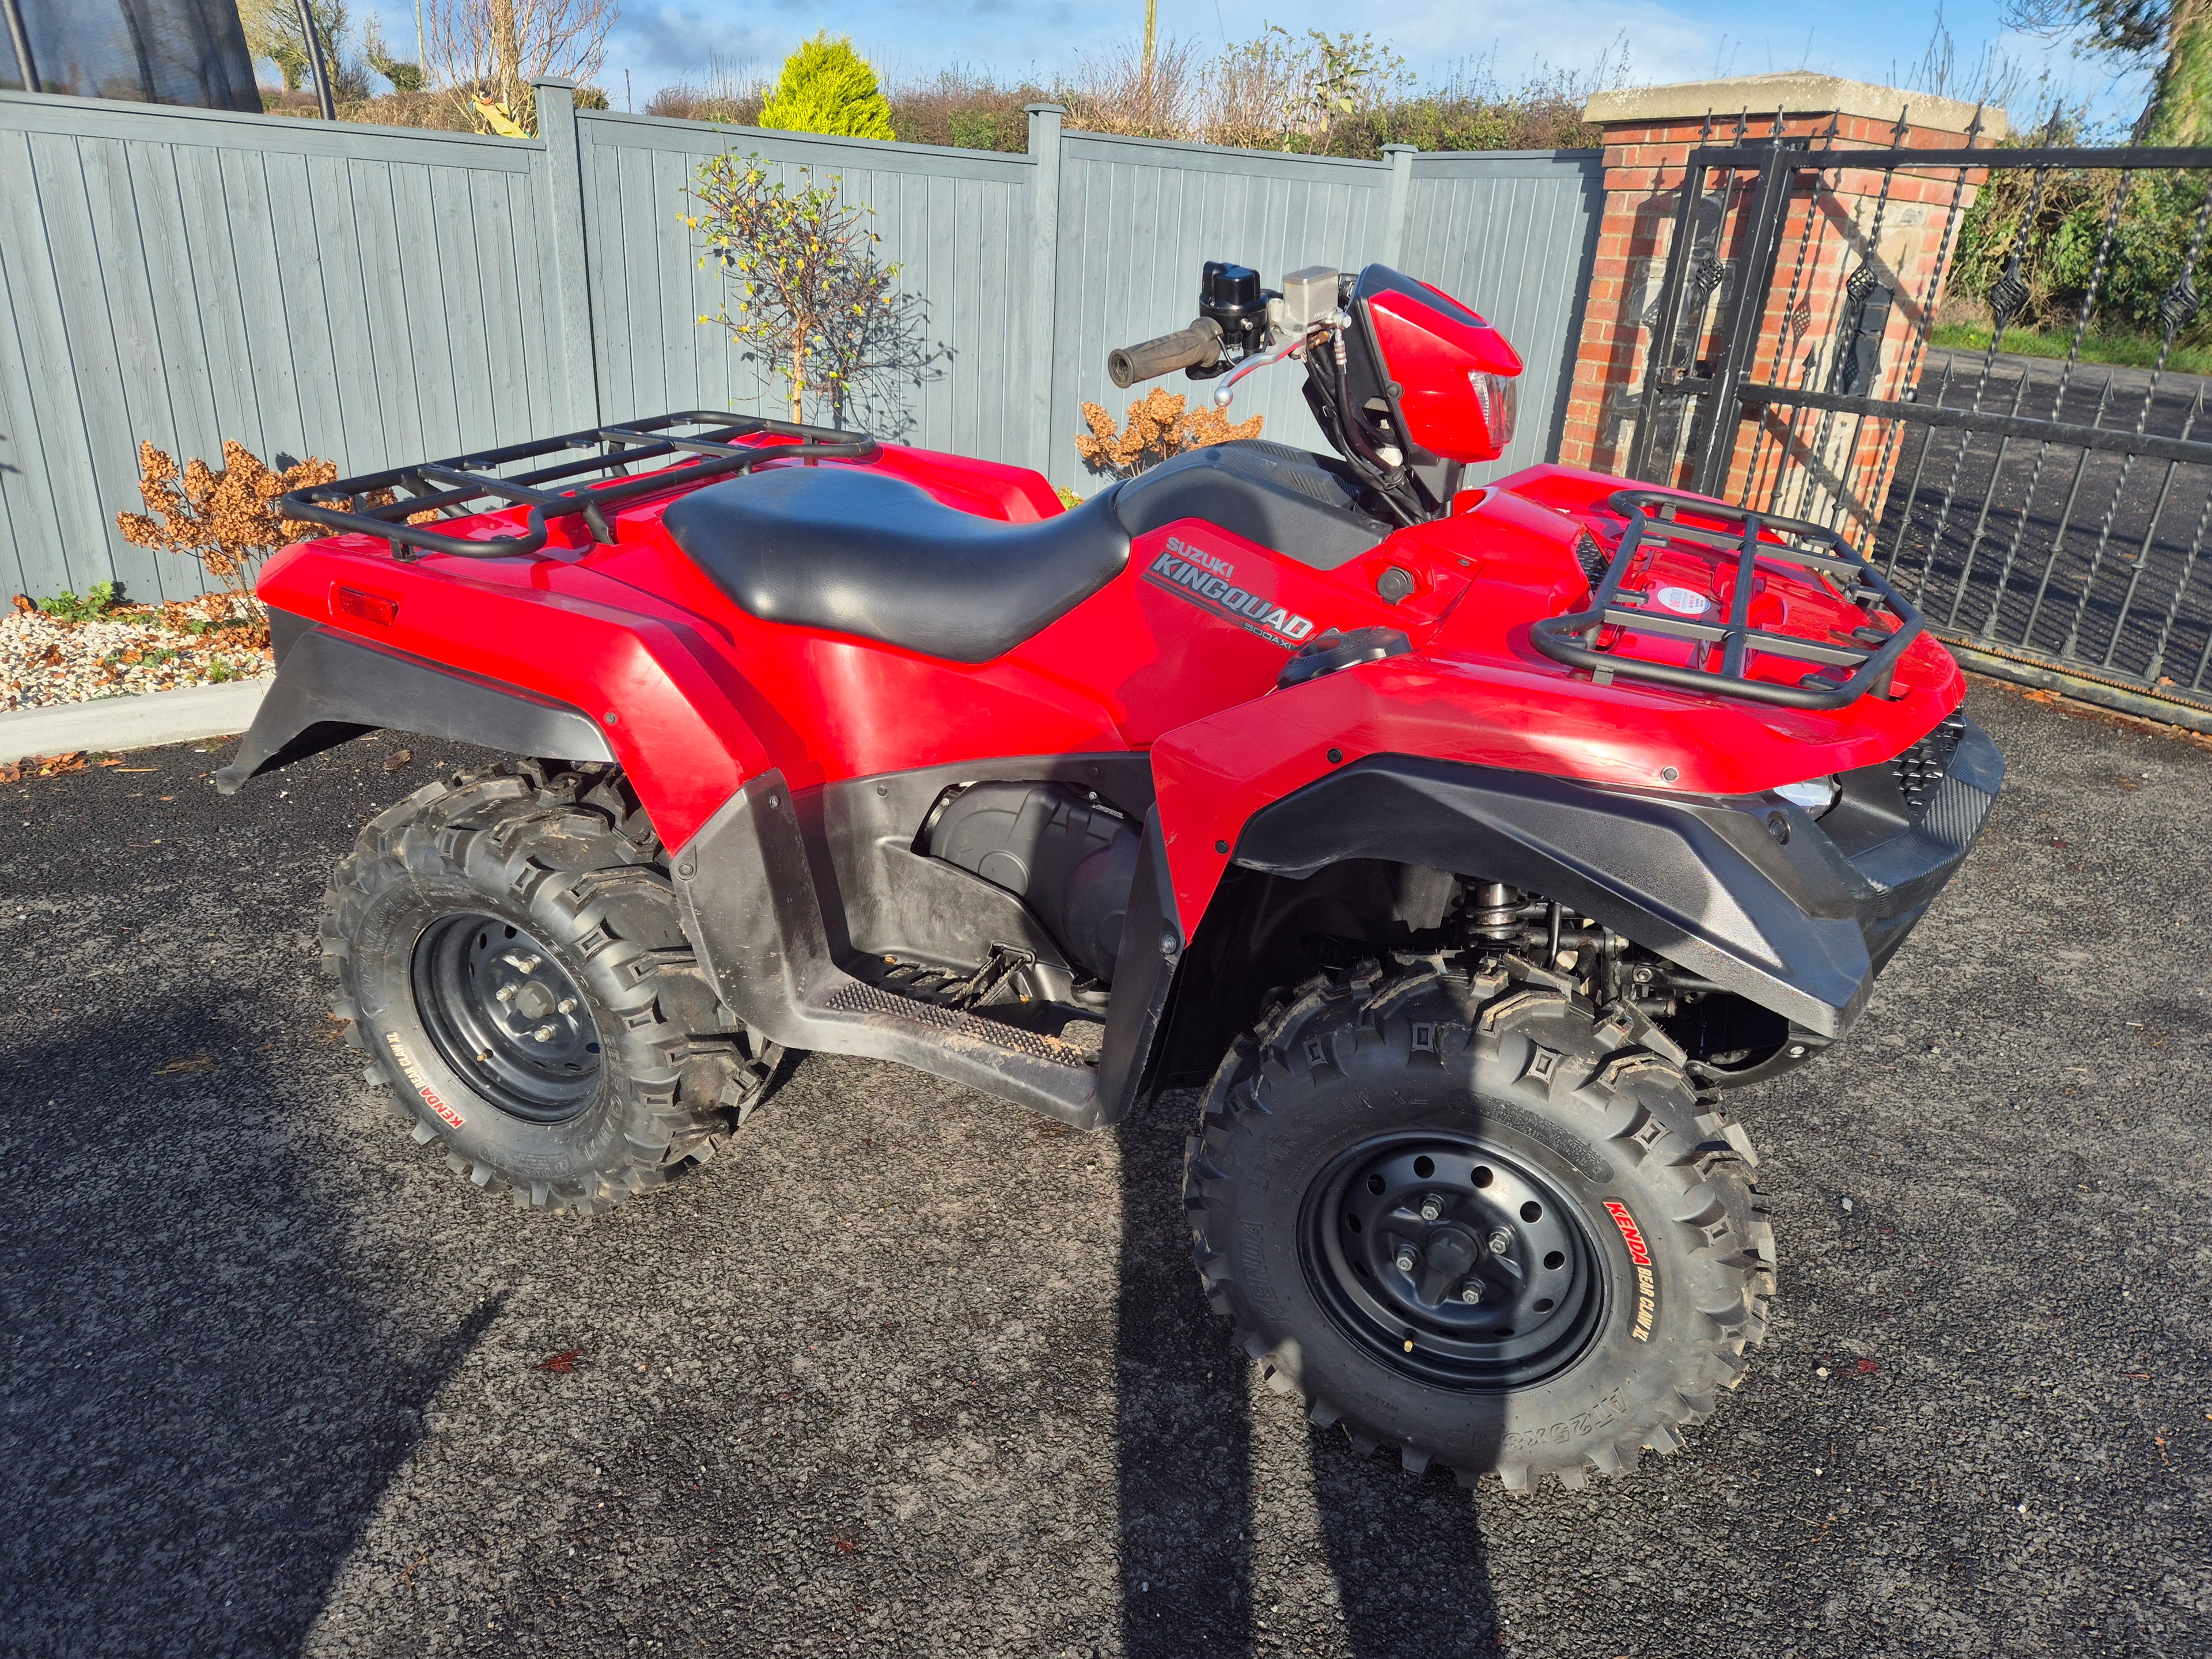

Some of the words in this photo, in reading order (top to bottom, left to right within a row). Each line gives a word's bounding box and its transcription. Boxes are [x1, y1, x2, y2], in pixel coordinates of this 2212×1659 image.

[1166, 537, 1234, 578] SUZUKI
[1151, 551, 1315, 639] KINGQUAD
[386, 1032, 400, 1043] XL
[391, 1044, 411, 1067] CLAW
[404, 1067, 426, 1089] BEAR
[419, 1086, 467, 1129] KENDA
[1603, 1202, 1652, 1266] KENDA
[1637, 1266, 1654, 1297] BEAR
[1637, 1296, 1654, 1331] CLAW
[1633, 1324, 1649, 1342] XL
